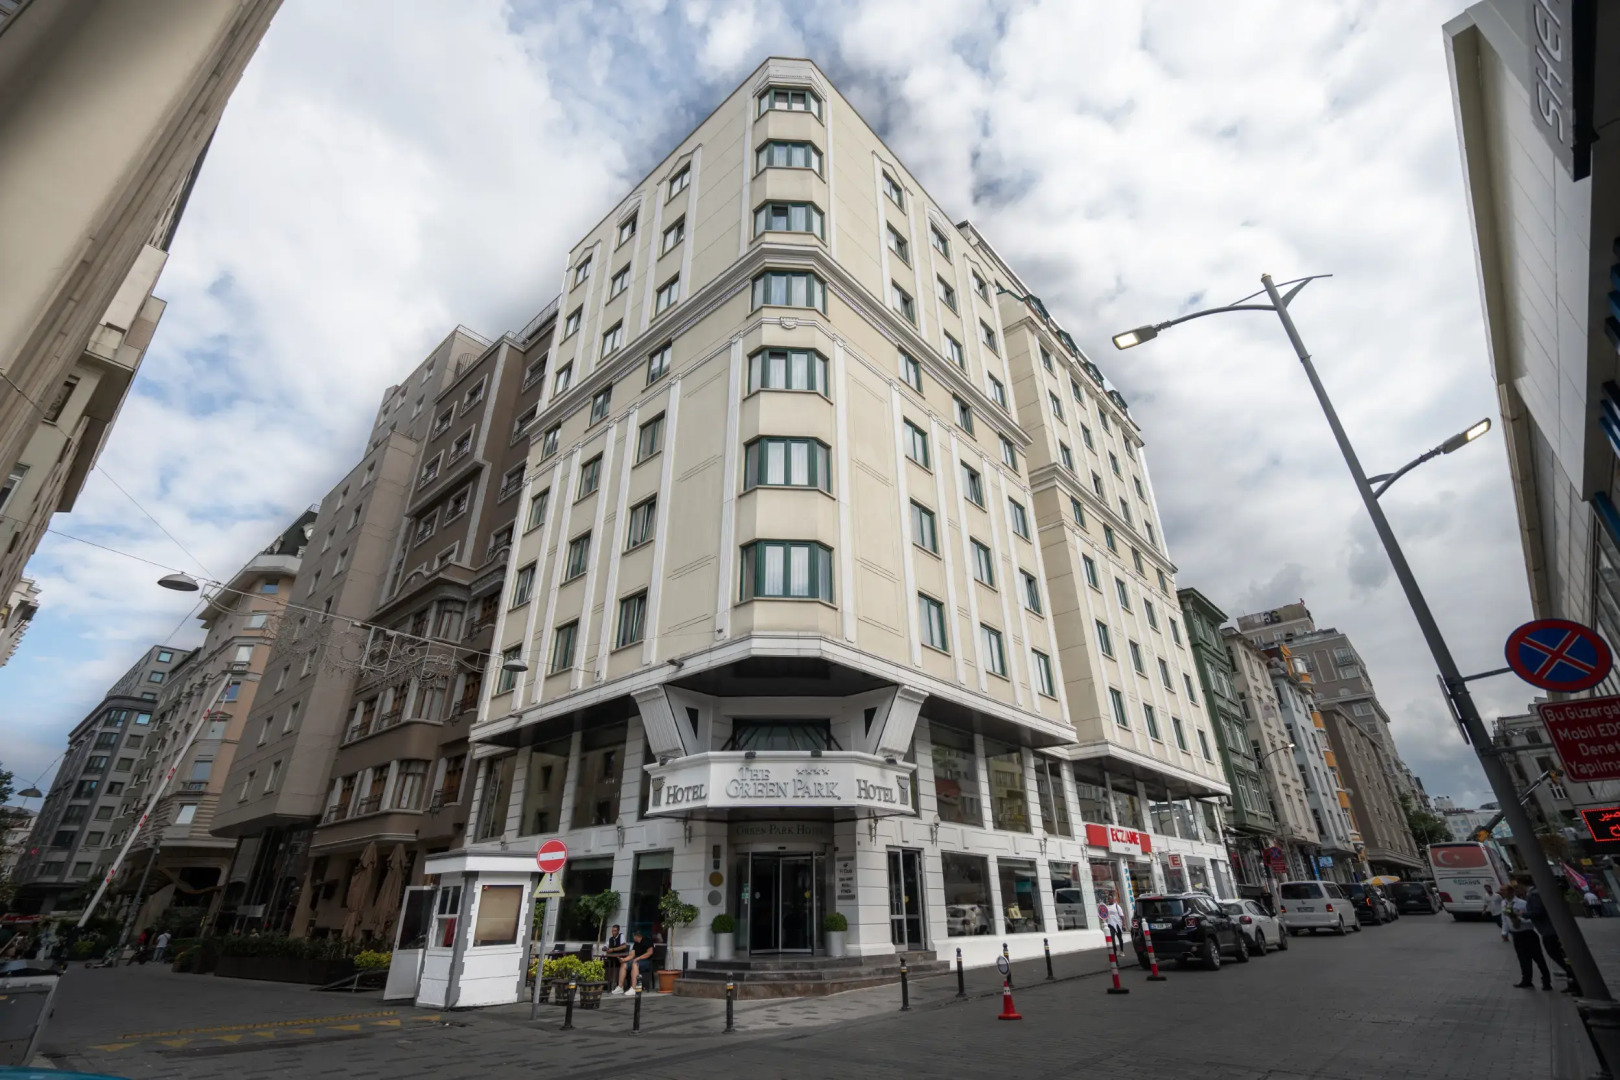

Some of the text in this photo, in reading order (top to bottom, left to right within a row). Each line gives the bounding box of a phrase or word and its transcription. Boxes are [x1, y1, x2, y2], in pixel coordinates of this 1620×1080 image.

[1545, 708, 1565, 721] Bu
[1557, 724, 1596, 741] Mobil
[738, 767, 771, 781] THE
[665, 783, 708, 805] HOTEL
[725, 778, 839, 799] GREEN PARK
[856, 778, 897, 804] HOTEL
[769, 823, 794, 835] PARK
[1110, 827, 1140, 846] ECZANE
